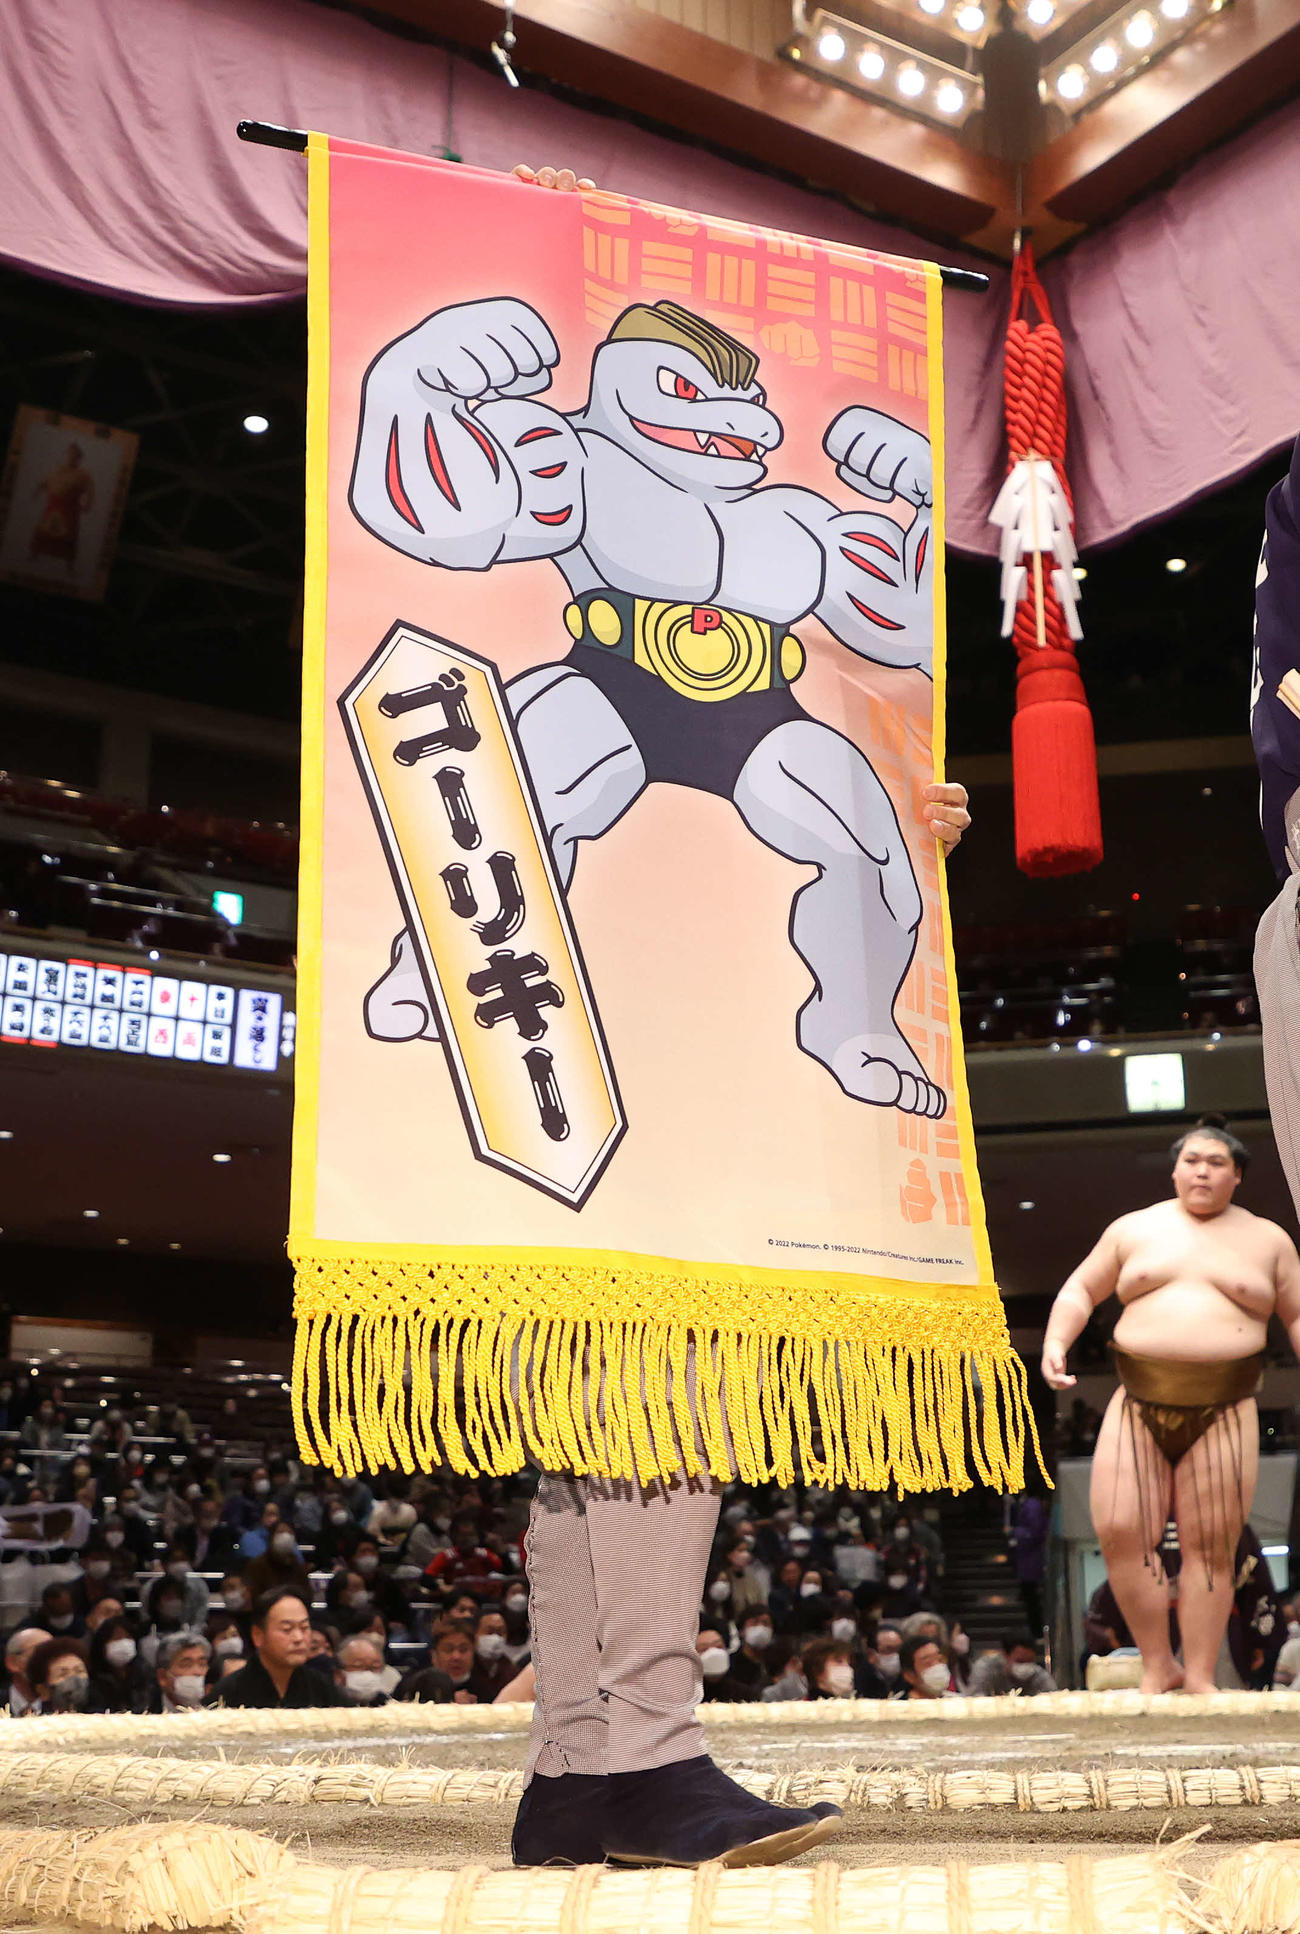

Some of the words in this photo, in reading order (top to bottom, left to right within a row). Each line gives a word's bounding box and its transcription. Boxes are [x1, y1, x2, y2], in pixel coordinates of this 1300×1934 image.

[690, 606, 723, 635] P
[378, 667, 571, 1142] ゴーリキー
[775, 1239, 790, 1247] 2022
[831, 1244, 860, 1253] 1995-2022
